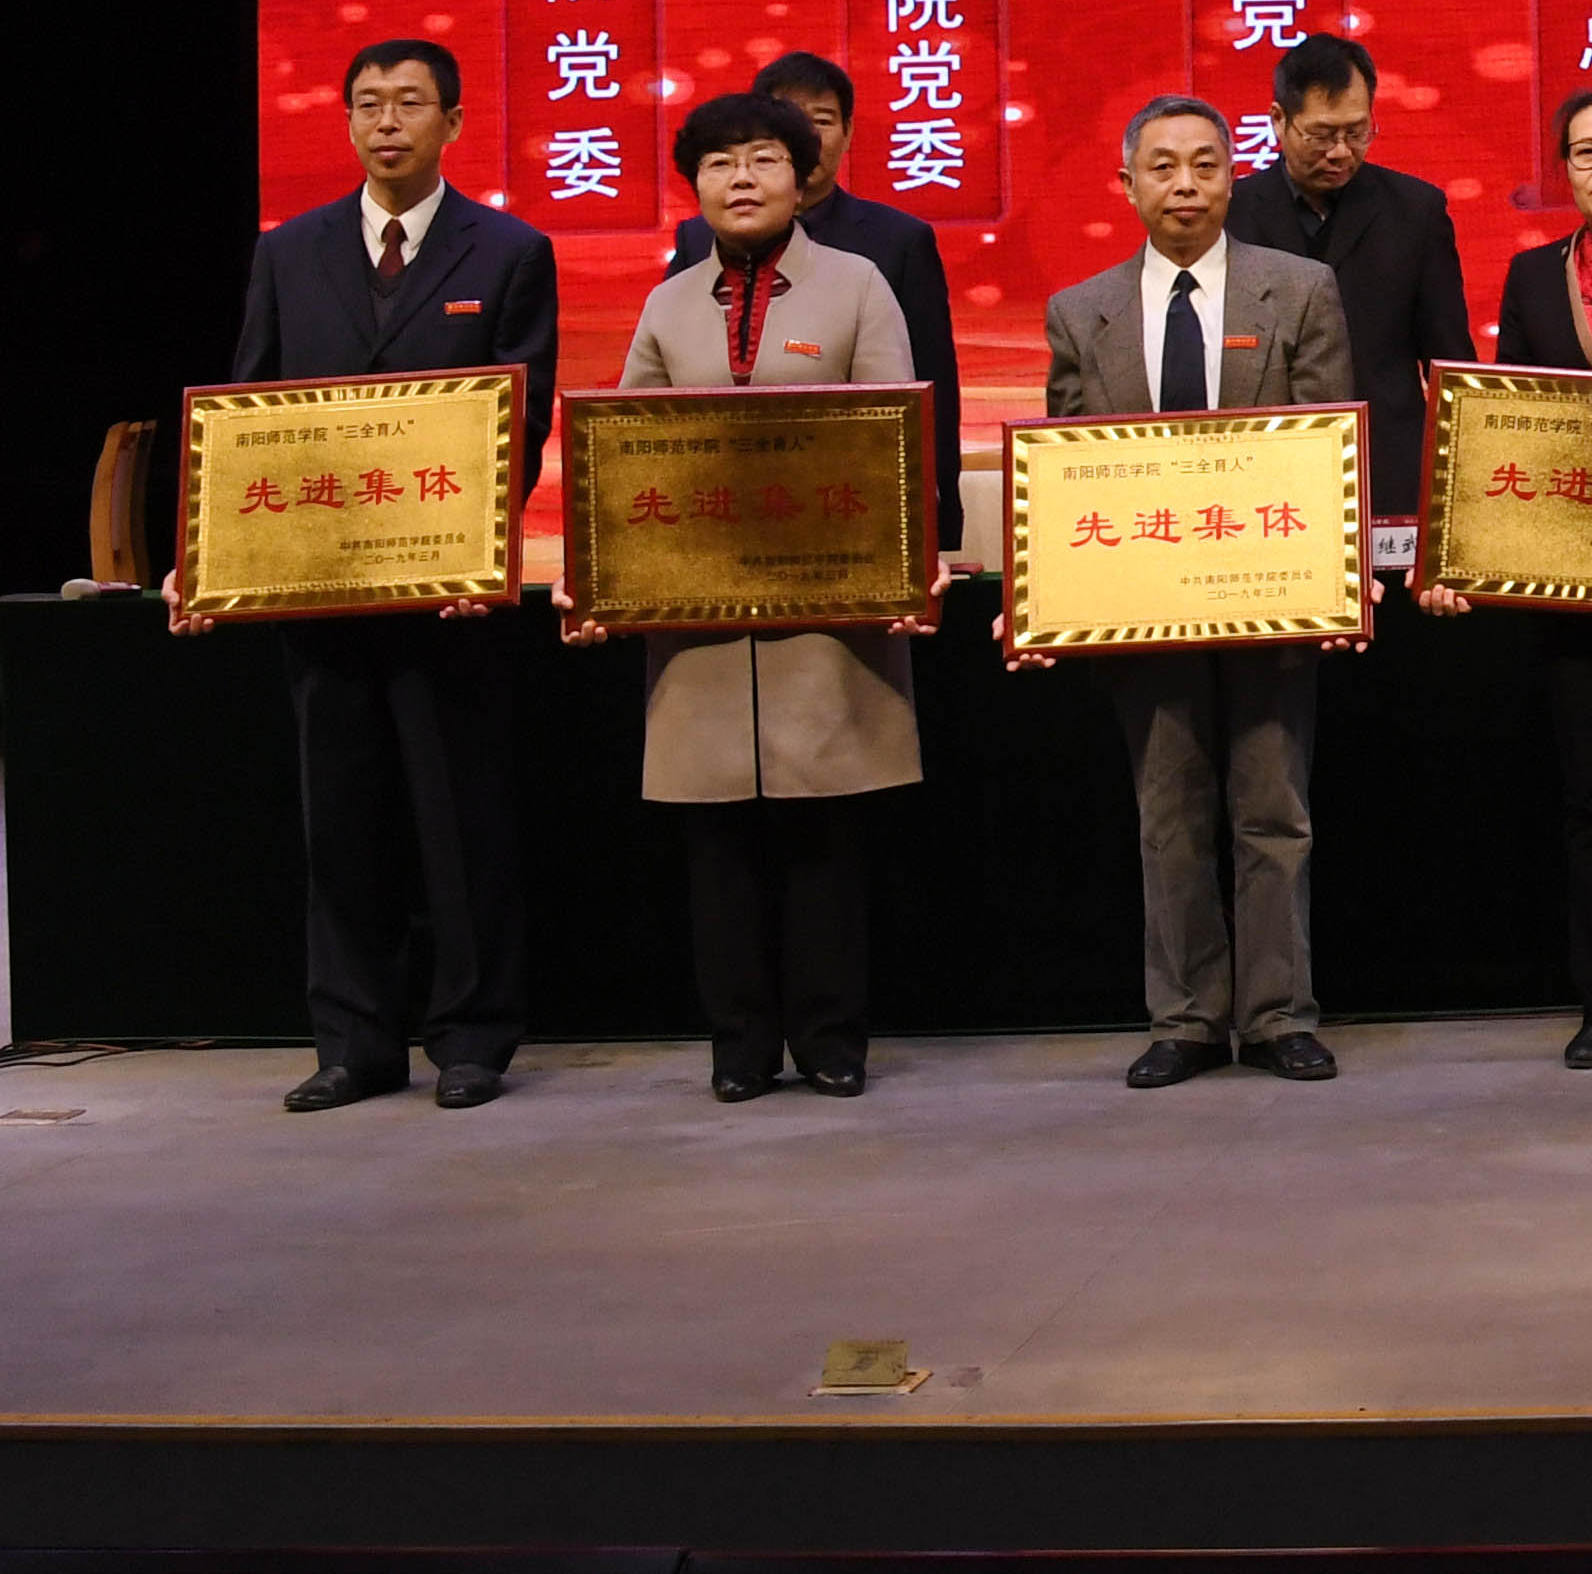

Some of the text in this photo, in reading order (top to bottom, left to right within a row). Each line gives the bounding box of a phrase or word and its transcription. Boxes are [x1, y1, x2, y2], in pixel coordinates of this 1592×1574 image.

[235, 420, 415, 447] 南阳师范学院“三全育人”
[1063, 456, 1254, 481] 南阳师范学院“三全育人”
[239, 465, 463, 514] 先进集体
[627, 483, 870, 525] 先进集体
[1070, 501, 1308, 547] 先进集体
[1207, 586, 1288, 601] 二〇一九年三月
